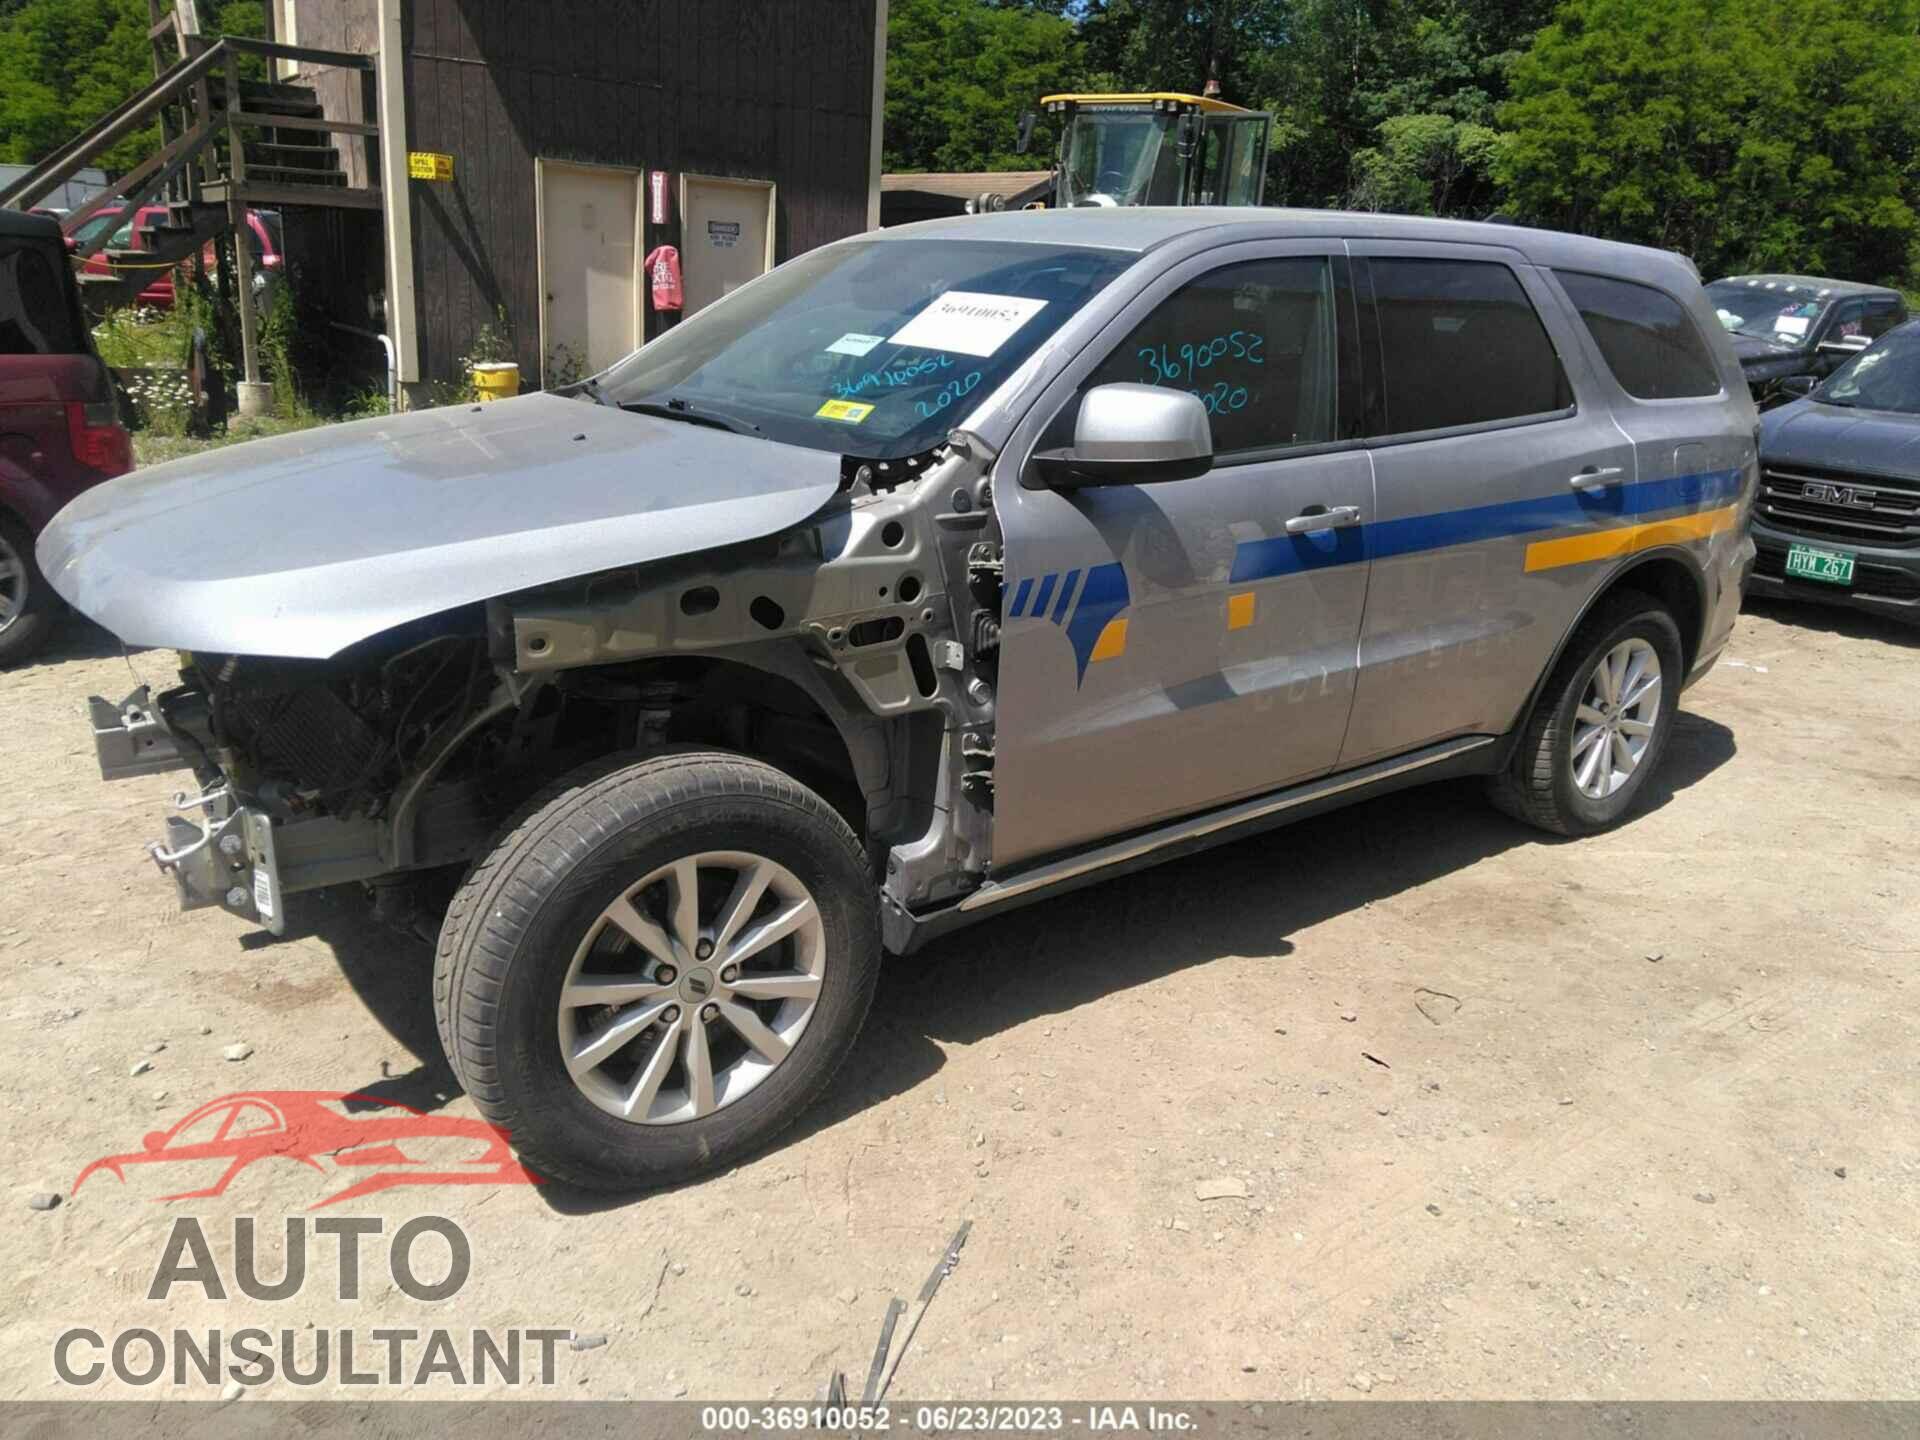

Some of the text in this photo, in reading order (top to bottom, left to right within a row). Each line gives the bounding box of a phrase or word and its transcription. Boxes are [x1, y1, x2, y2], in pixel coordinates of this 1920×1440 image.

[914, 371, 982, 418] 2020
[1802, 482, 1877, 510] GMC
[1823, 558, 1849, 577] 267
